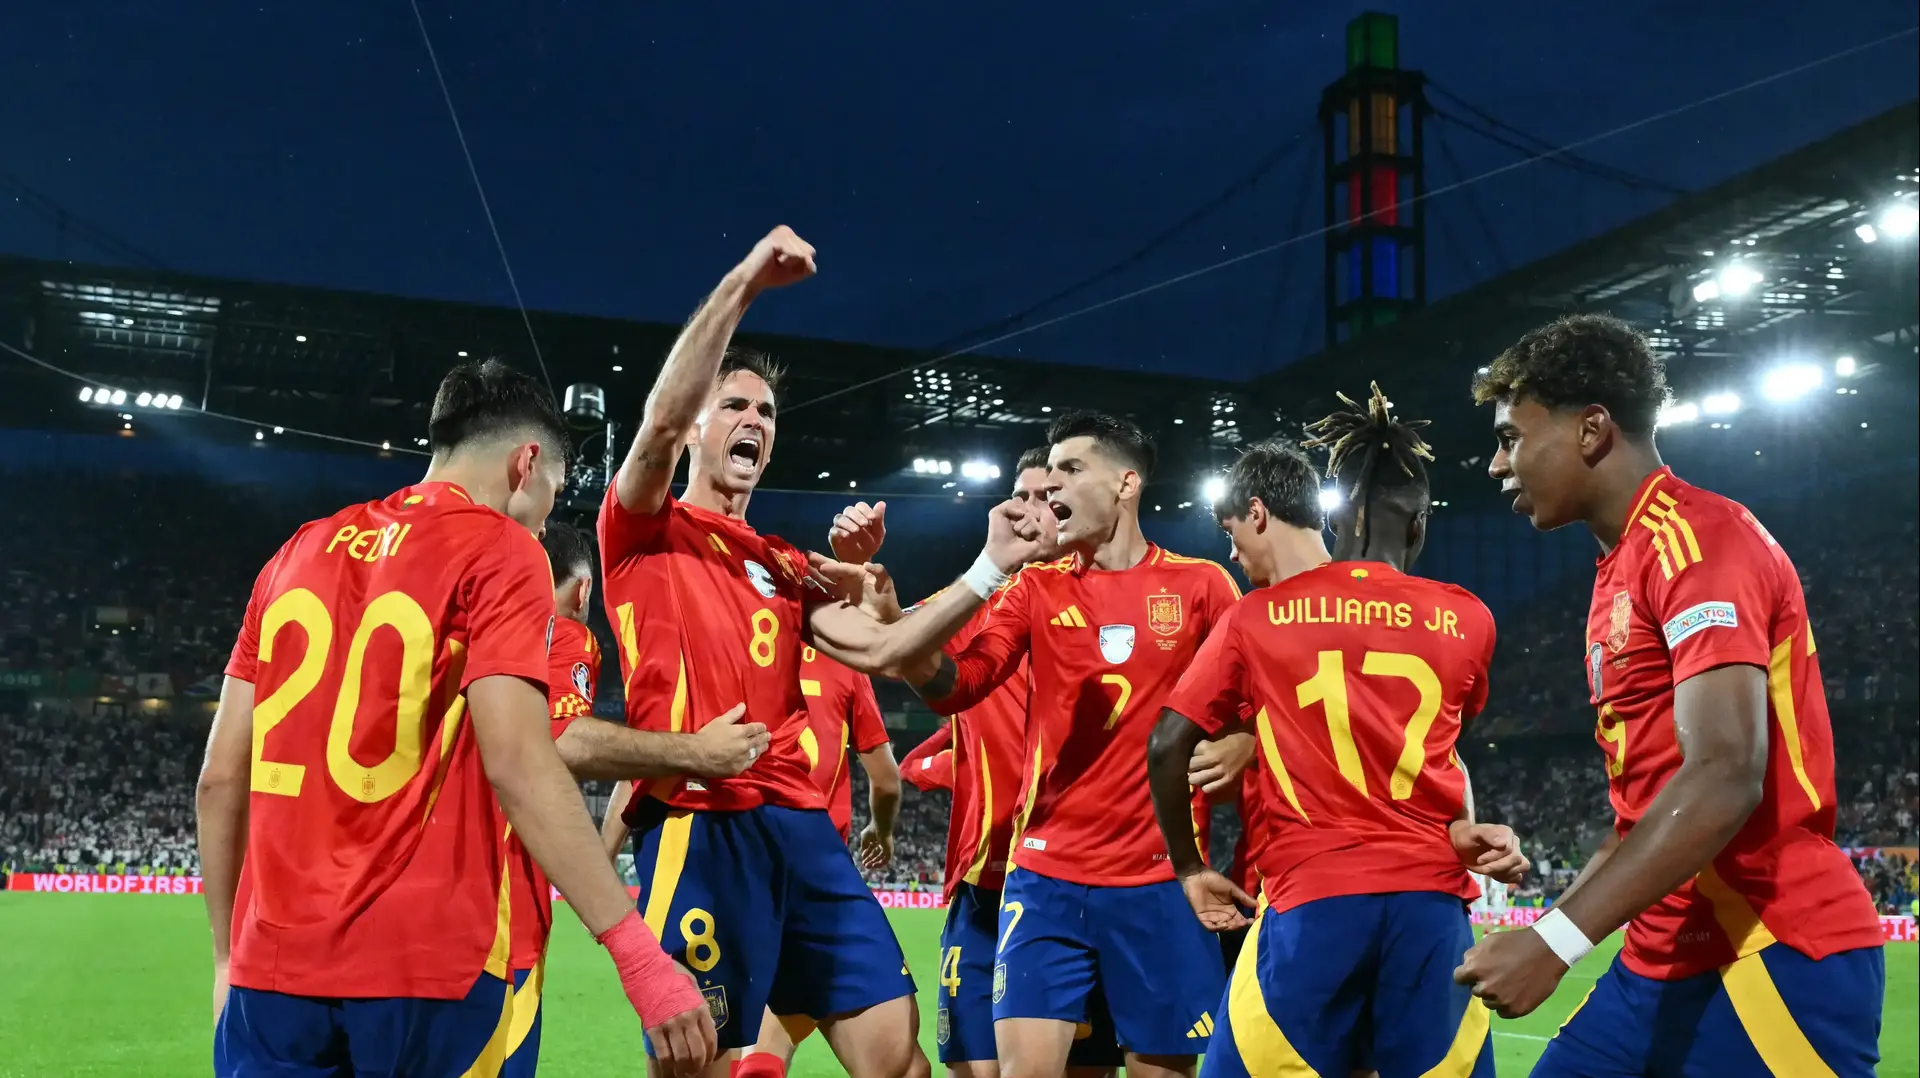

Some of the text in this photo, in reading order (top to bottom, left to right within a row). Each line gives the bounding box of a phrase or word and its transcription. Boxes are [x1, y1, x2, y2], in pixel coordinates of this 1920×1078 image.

[325, 521, 413, 563] PEDRI
[749, 608, 780, 668] 8
[1267, 597, 1465, 640] WILLIAMS JR.
[1666, 608, 1735, 640] FOUNDATION
[250, 587, 435, 804] 20
[1101, 674, 1133, 731] 7
[1295, 649, 1443, 801] 17
[32, 874, 203, 894] WORLDFIRST
[679, 907, 721, 973] 8
[997, 900, 1025, 955] 7
[940, 945, 962, 997] 4
